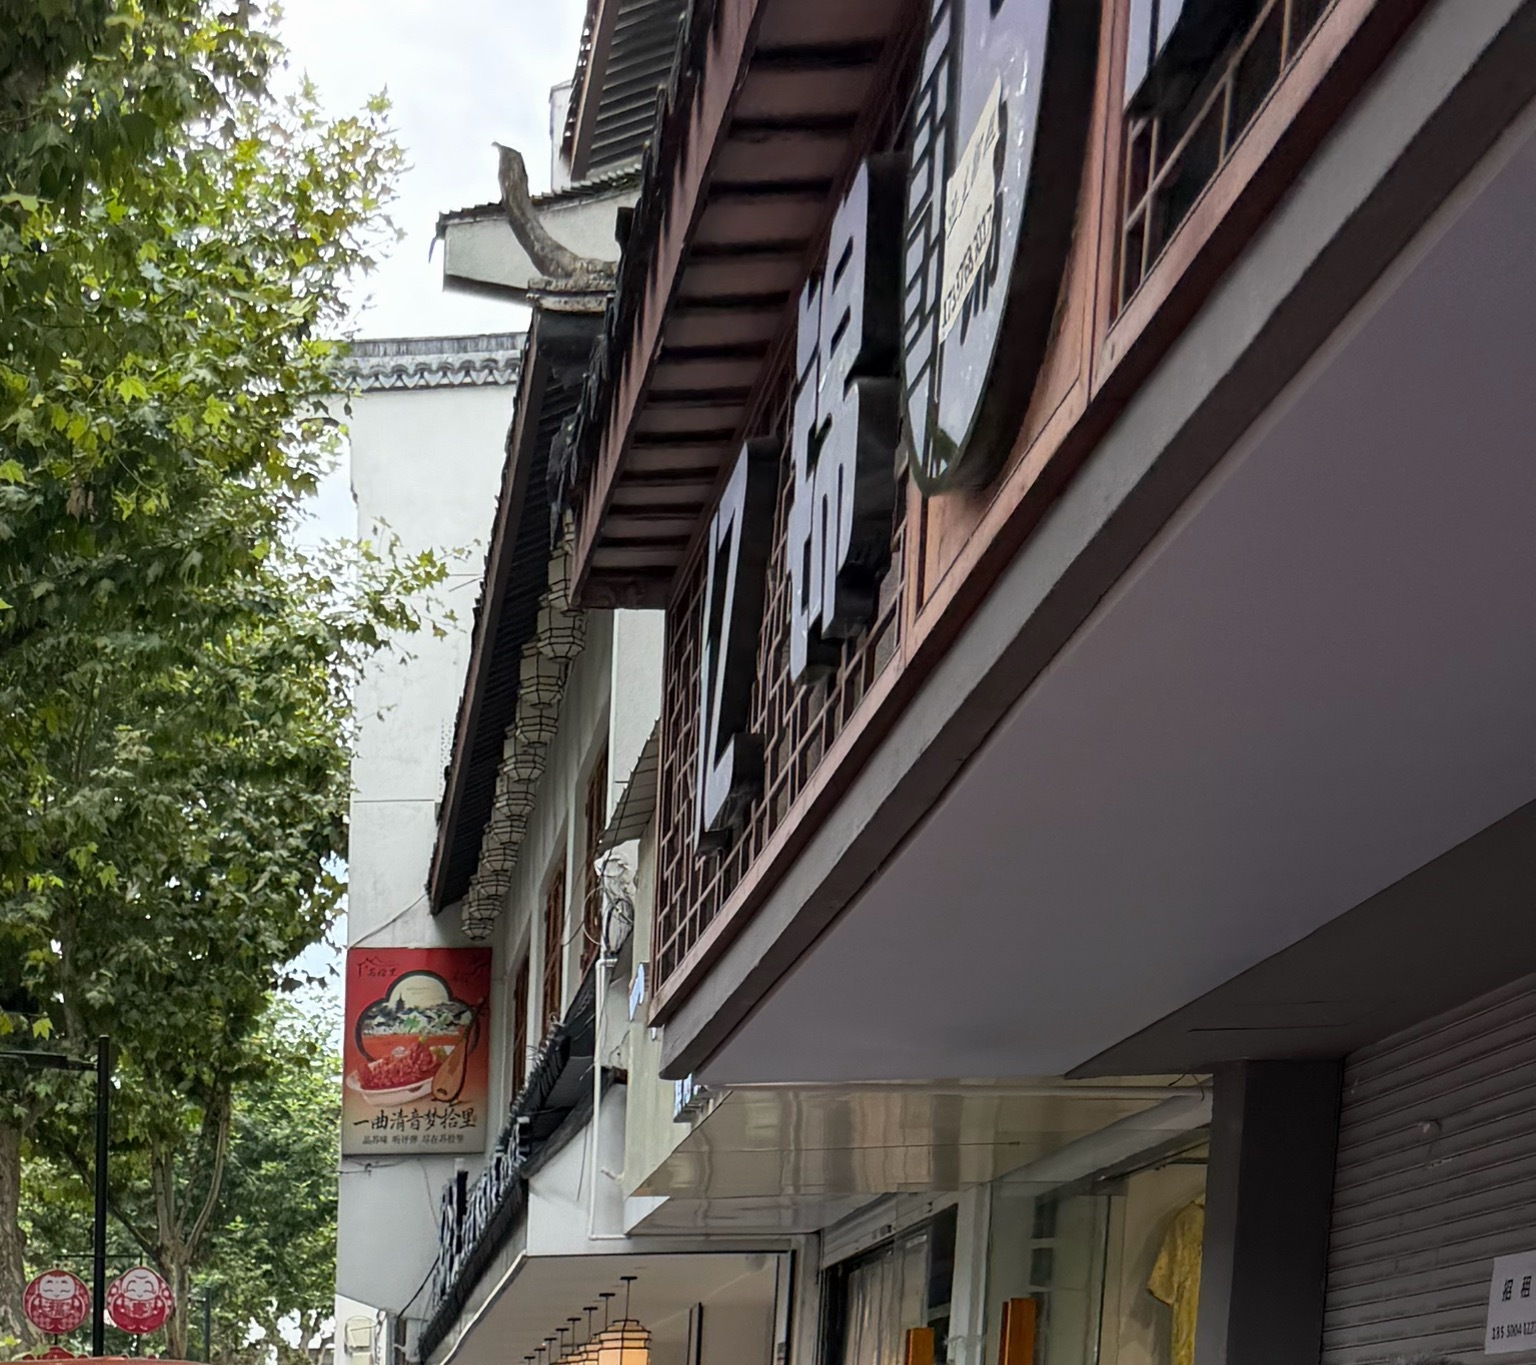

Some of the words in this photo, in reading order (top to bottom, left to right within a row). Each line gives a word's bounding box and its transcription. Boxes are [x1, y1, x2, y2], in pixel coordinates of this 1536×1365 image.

[353, 1107, 476, 1132] 一曲清音梦拾里
